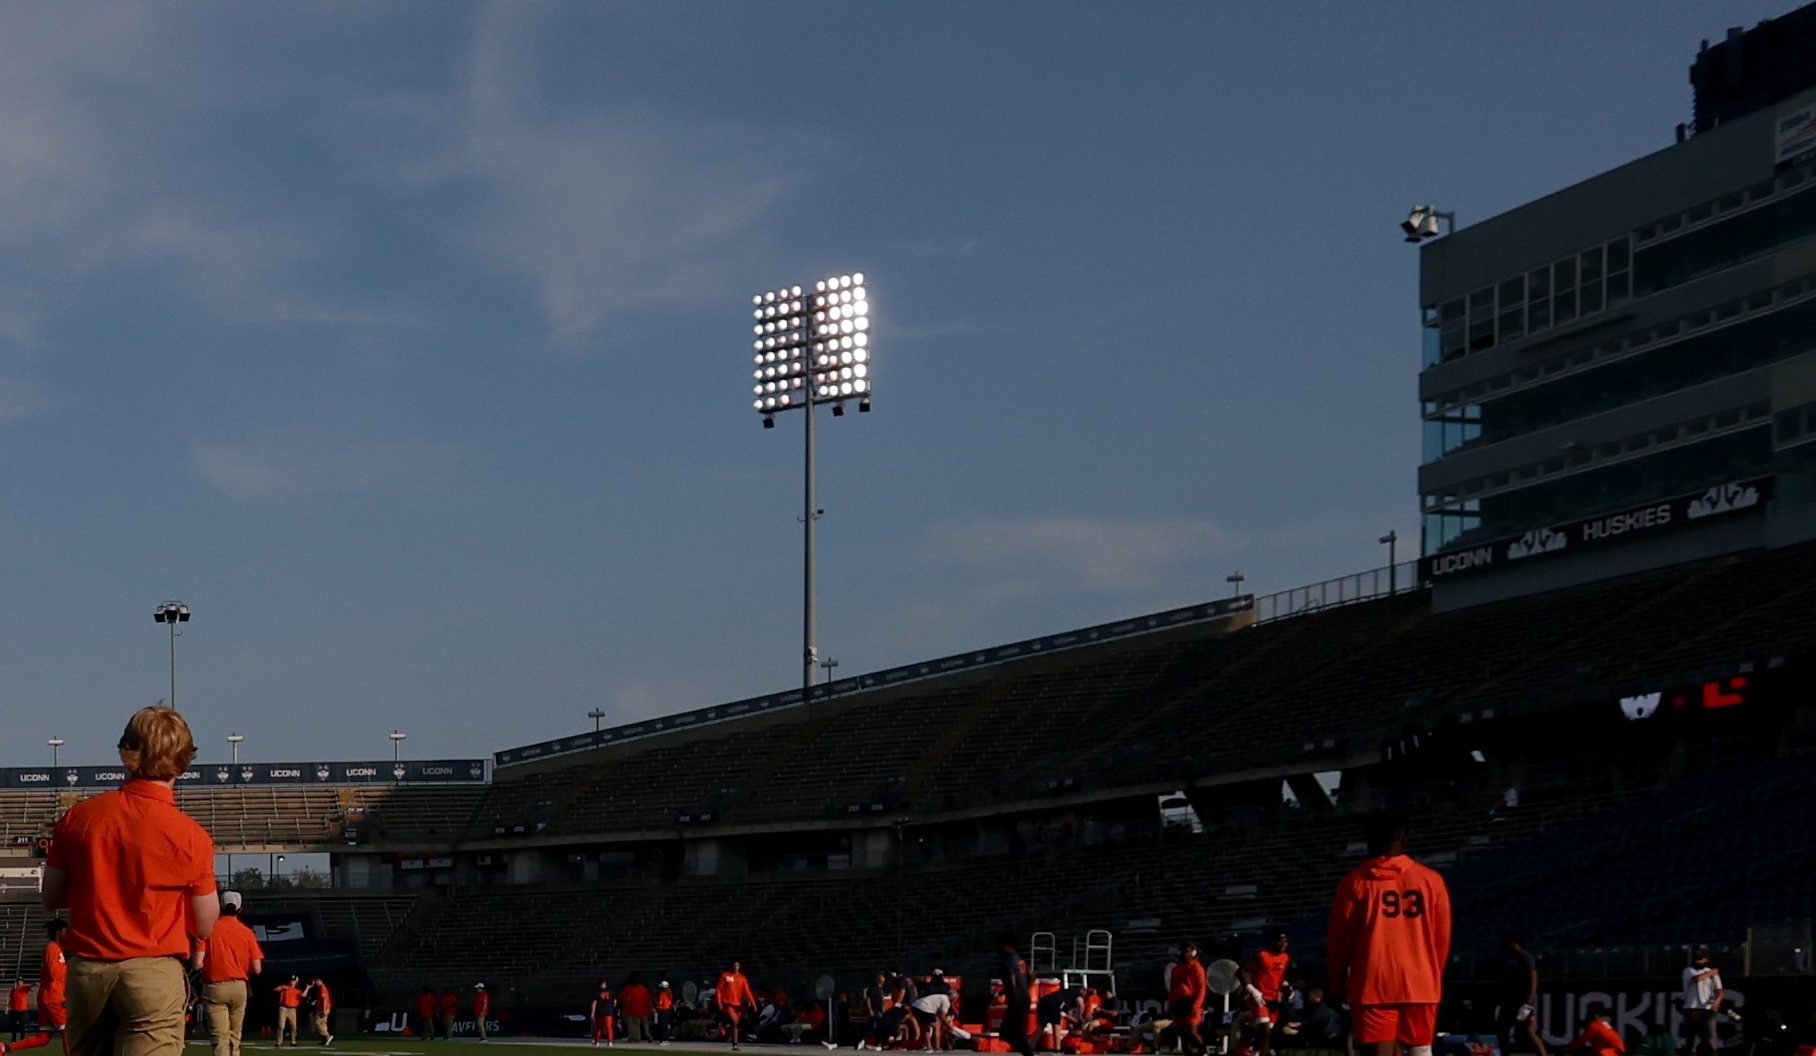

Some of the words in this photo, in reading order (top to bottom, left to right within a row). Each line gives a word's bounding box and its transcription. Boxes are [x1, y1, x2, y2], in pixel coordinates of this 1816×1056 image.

[1432, 546, 1493, 575] UCONN
[1583, 504, 1671, 541] HUSKIES
[270, 768, 301, 778] UCONN
[345, 767, 377, 777] UCONN
[422, 766, 453, 776] UCONN
[19, 773, 50, 783] UCONN
[95, 772, 126, 782] UCONN
[1381, 889, 1423, 919] 93
